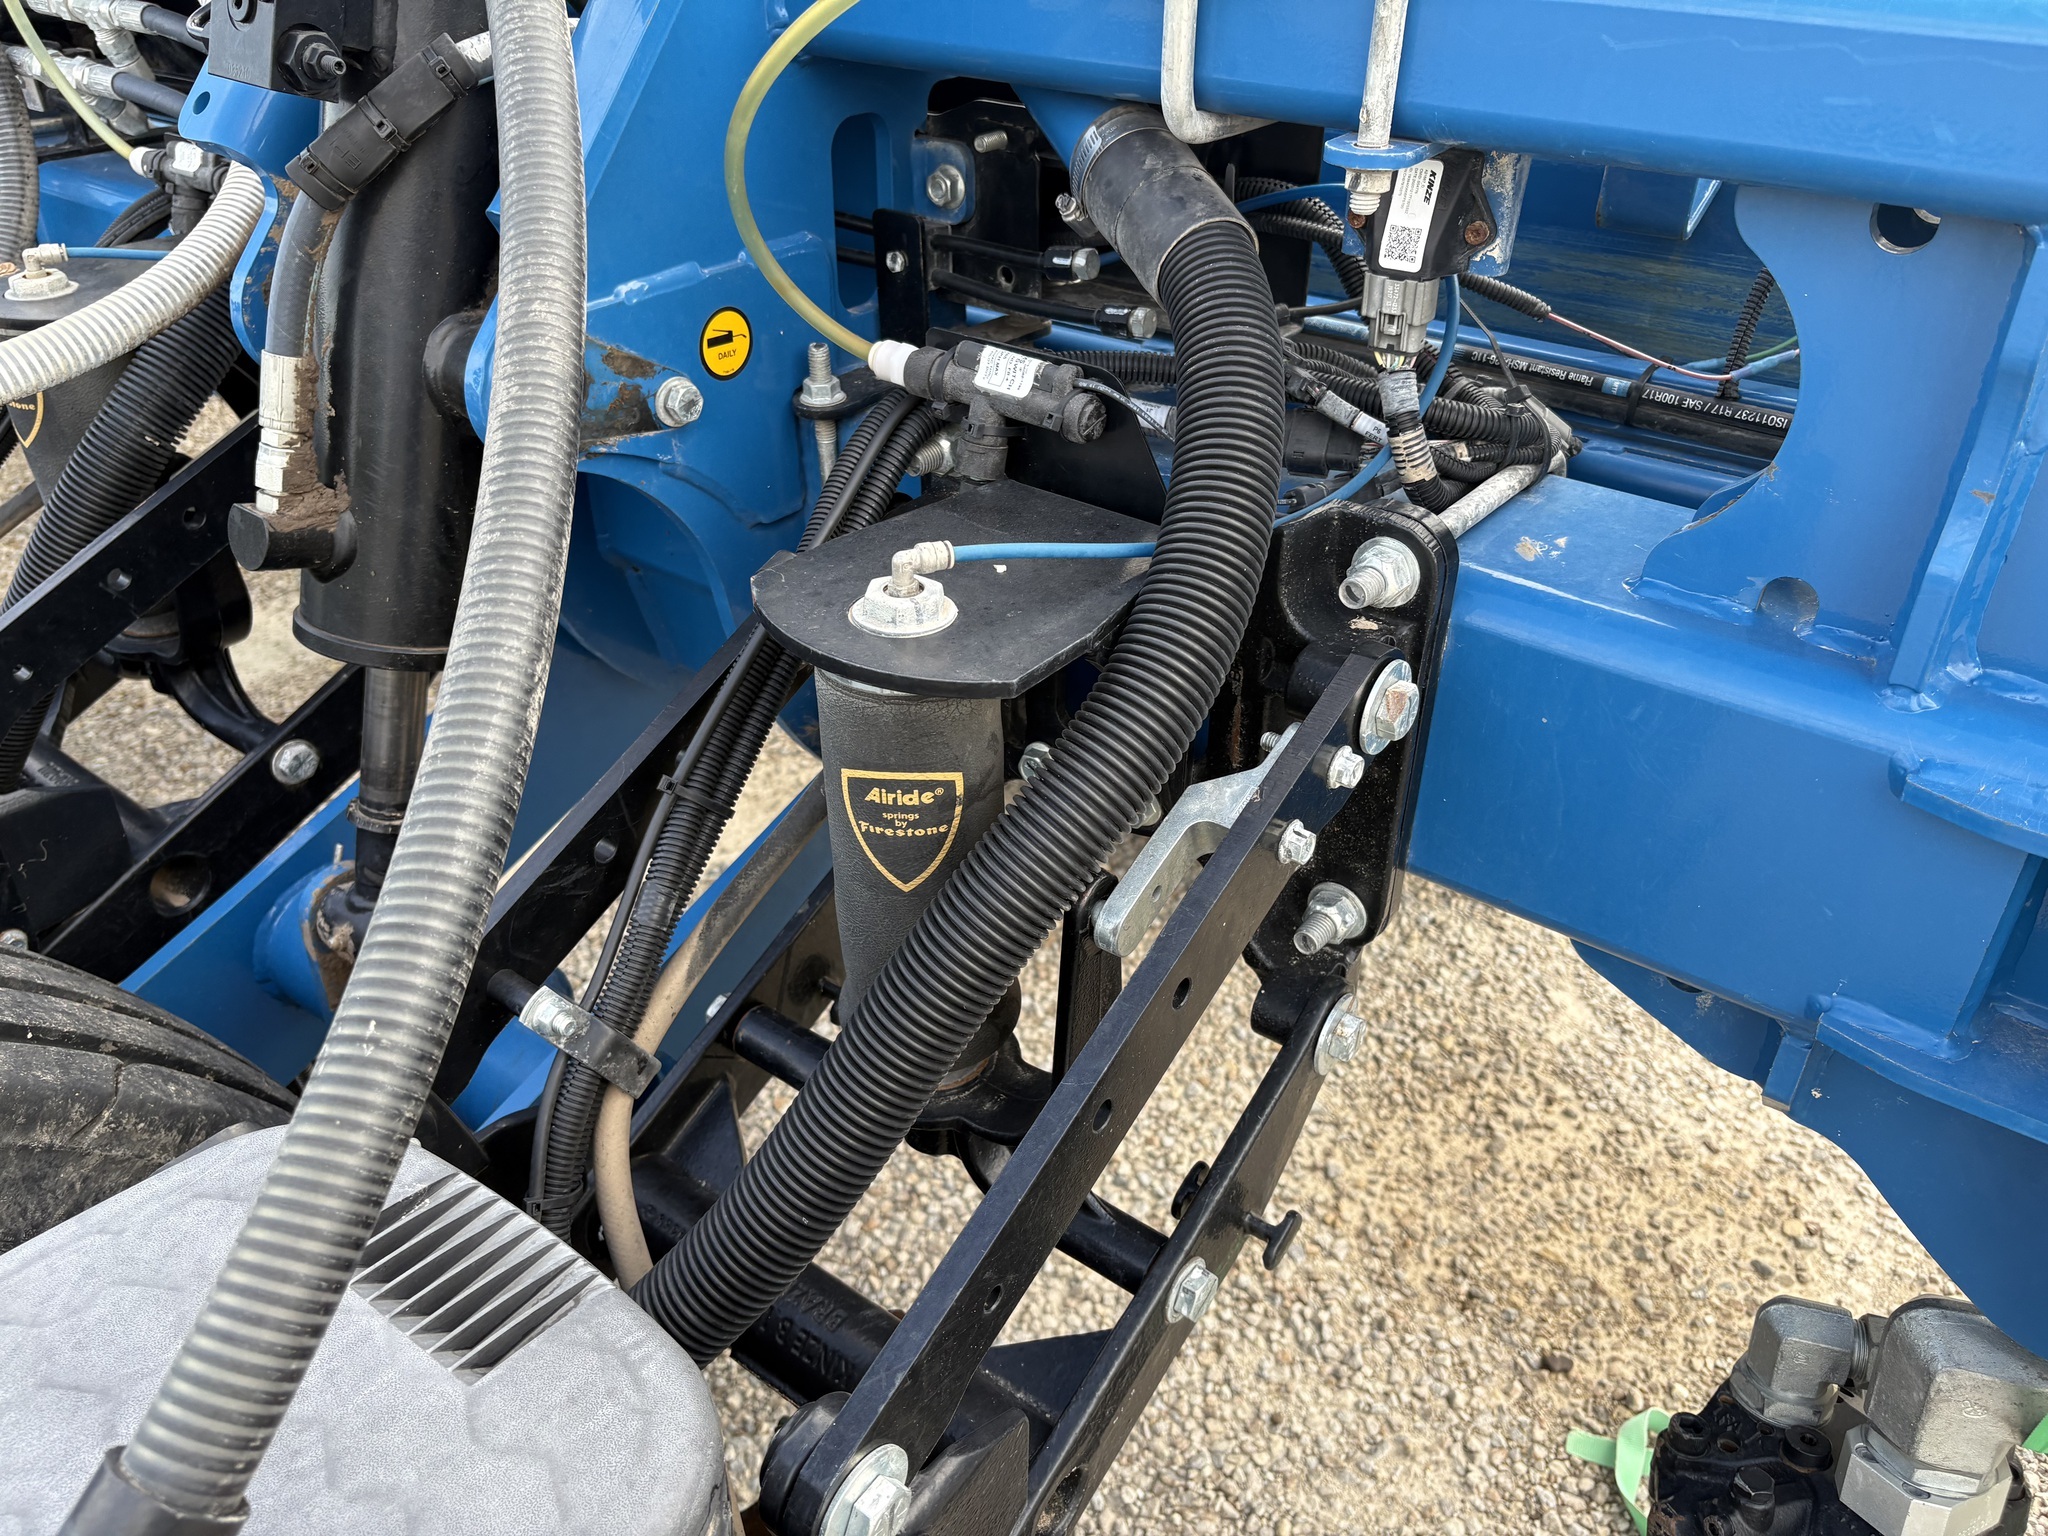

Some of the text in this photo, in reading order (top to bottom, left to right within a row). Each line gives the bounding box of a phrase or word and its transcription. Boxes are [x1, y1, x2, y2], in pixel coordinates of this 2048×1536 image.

[1423, 169, 1437, 206] KINZE
[717, 349, 737, 360] DAILY
[1528, 363, 1567, 381] Resistant
[1567, 373, 1594, 387] Flame
[1641, 388, 1680, 406] 100R17
[1711, 406, 1733, 418] R17
[1733, 409, 1788, 429] ISO11237
[1365, 430, 1382, 443] FERT
[1372, 425, 1382, 435] P6
[882, 812, 920, 822] springs
[895, 819, 908, 828] by
[858, 820, 949, 837] Firestone
